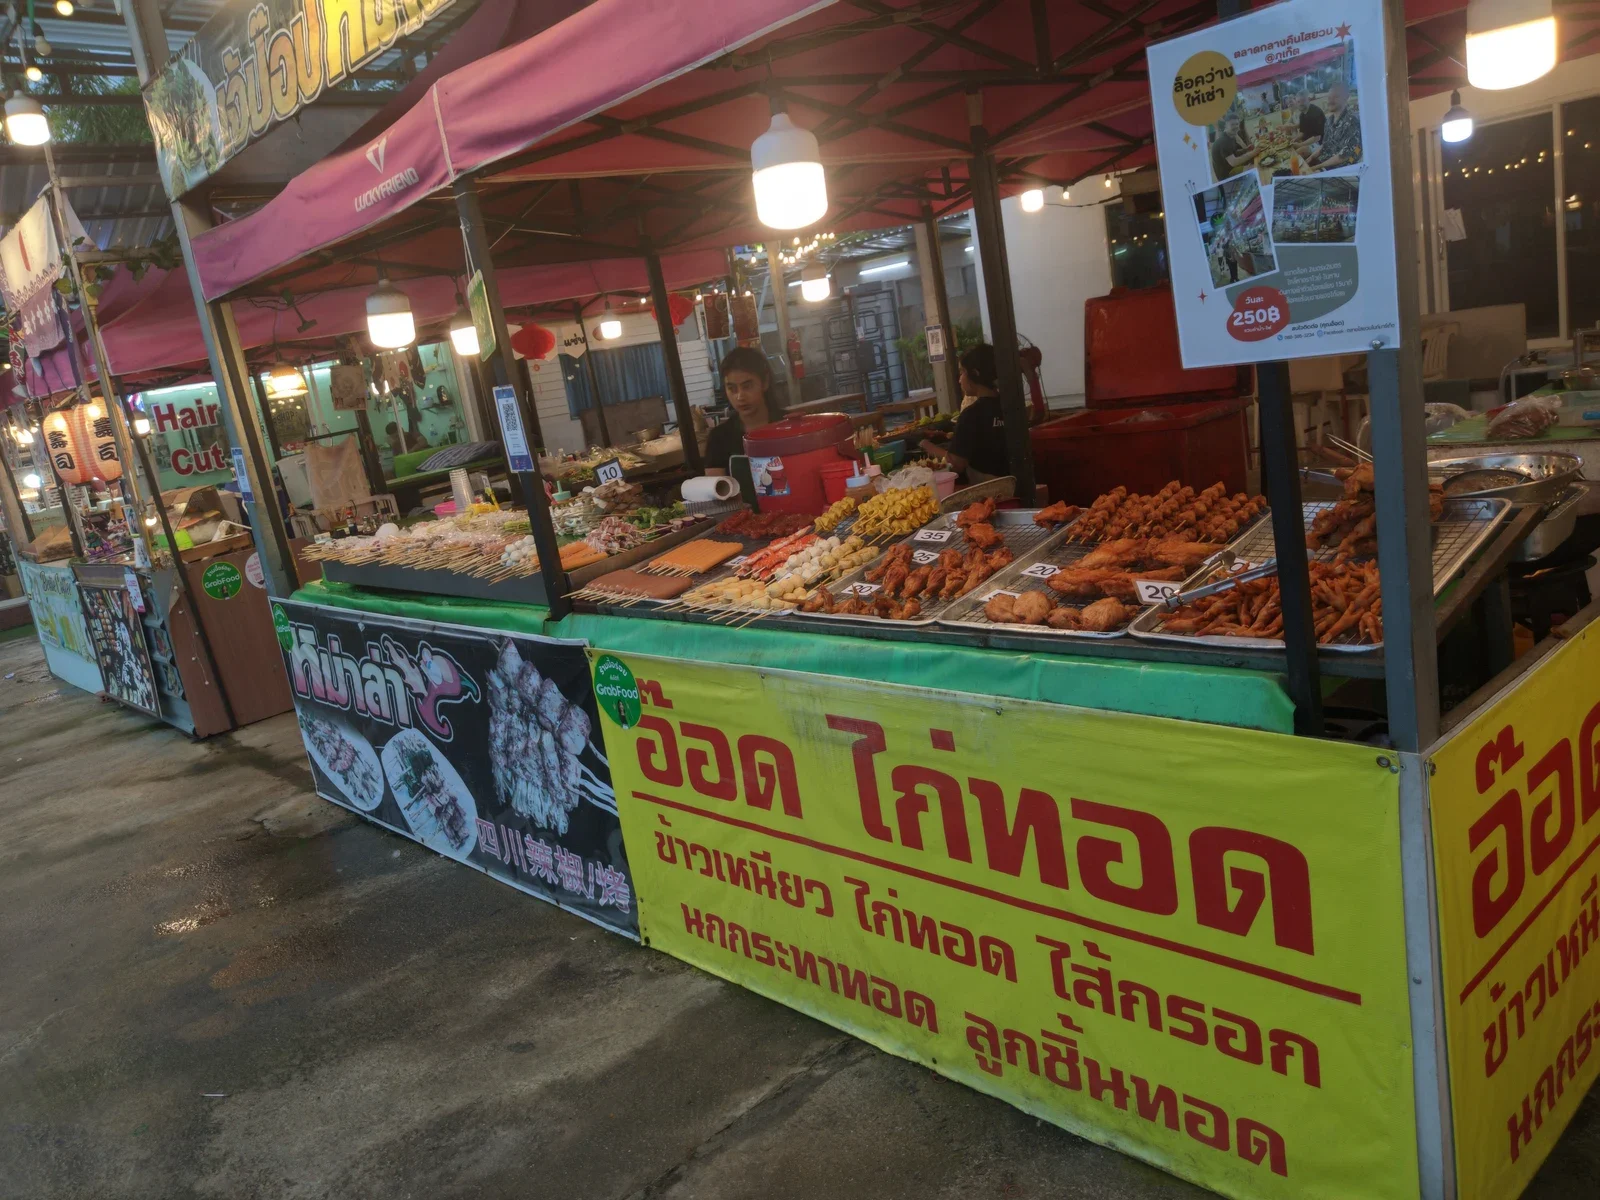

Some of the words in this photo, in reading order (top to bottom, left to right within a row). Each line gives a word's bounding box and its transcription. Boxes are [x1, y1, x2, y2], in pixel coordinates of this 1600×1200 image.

[1174, 66, 1235, 93] ล็อคว่าง
[1184, 85, 1225, 108] ให้เช่า
[354, 167, 419, 212] LUCKYFRIEND
[1245, 296, 1264, 304] วันละ
[151, 398, 219, 434] Hair
[171, 441, 228, 477] Cut
[602, 466, 618, 481] 10
[920, 531, 946, 540] 35
[913, 552, 934, 562] 25
[1027, 565, 1057, 576] 20
[204, 573, 241, 589] GrabFood
[1144, 584, 1176, 600] 20
[596, 682, 639, 699] GrabFood
[635, 677, 803, 820] อ๊อด
[825, 713, 1315, 956] ไก่ทอด
[654, 813, 835, 918] ข้าวเหนียว
[844, 875, 1018, 984] ไก่ทอด
[1035, 934, 1322, 1089] ไส้กรอก
[680, 902, 940, 1034] นกกระทาทอด
[964, 1010, 1289, 1178] ลูกชิ้นทอด
